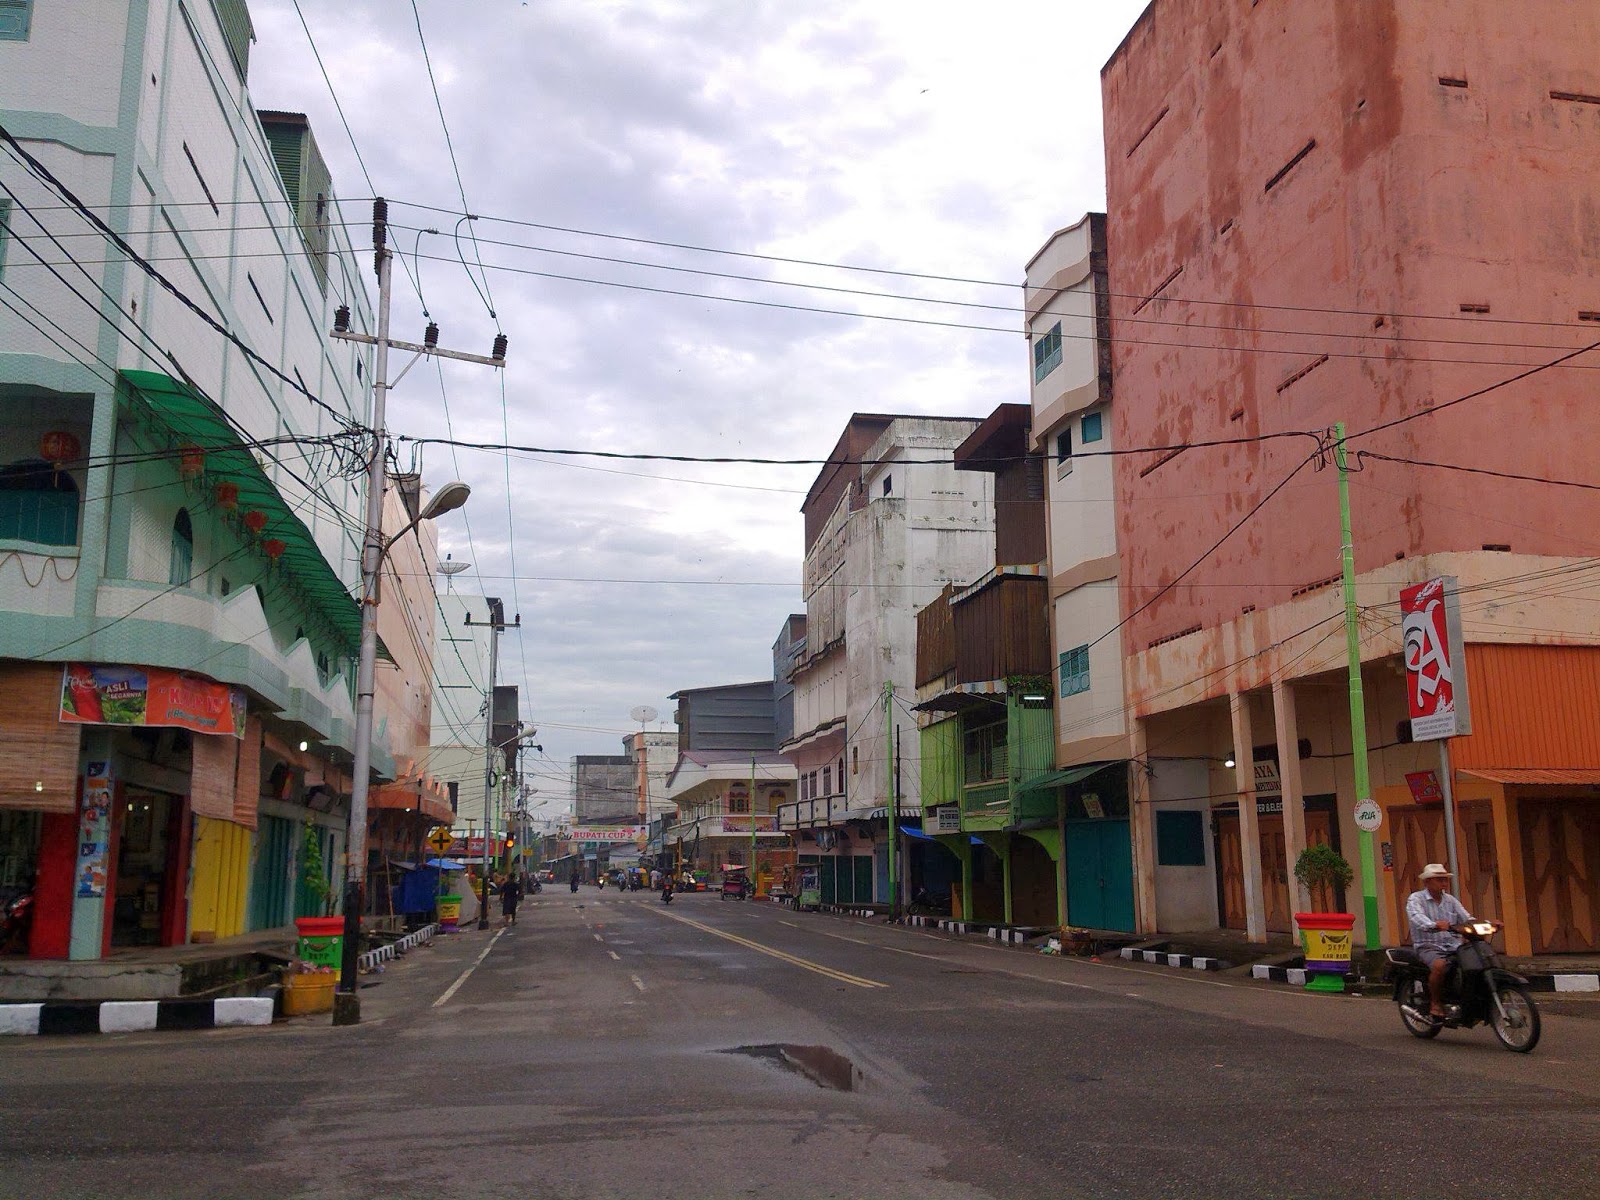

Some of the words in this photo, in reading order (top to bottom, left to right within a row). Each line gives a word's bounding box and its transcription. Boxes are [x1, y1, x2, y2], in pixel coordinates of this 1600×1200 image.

[106, 681, 128, 693] ASLI
[572, 831, 606, 839] BUPATI
[608, 831, 626, 839] CUP
